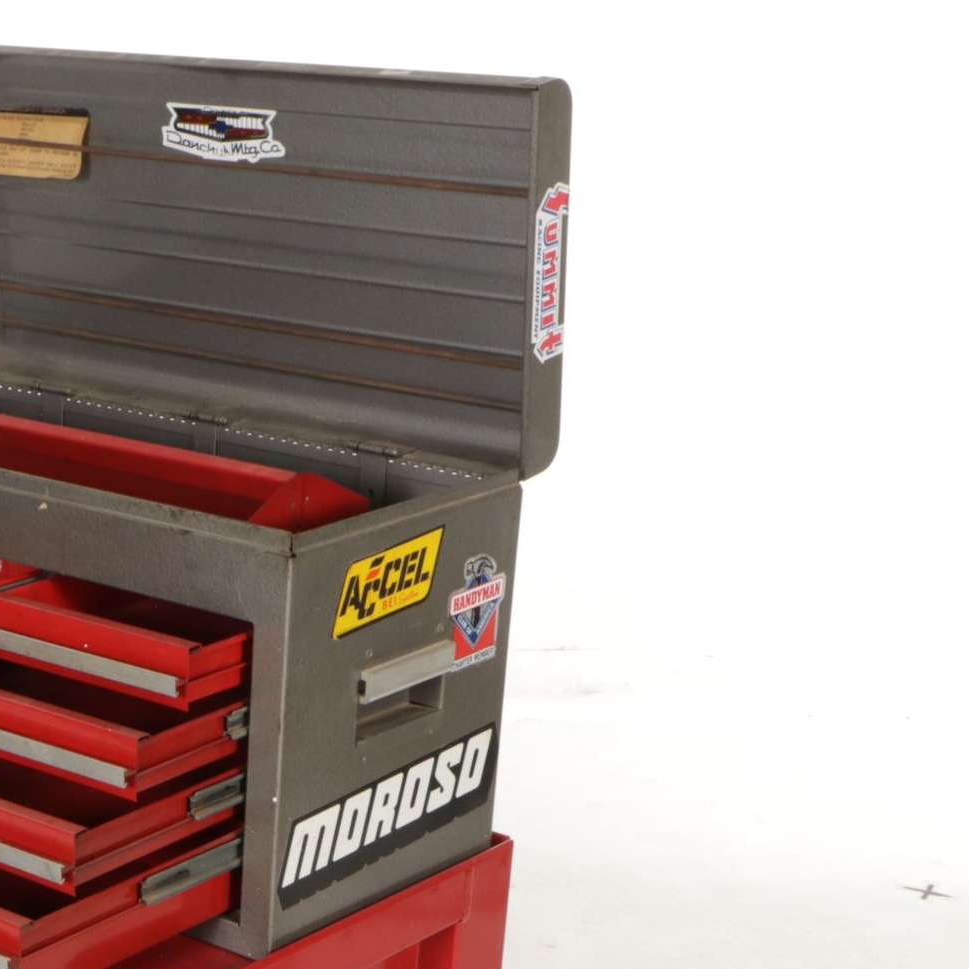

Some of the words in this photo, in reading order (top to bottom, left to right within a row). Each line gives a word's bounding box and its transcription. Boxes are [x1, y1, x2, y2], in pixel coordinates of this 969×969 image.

[339, 546, 430, 620] ACCEL
[453, 580, 501, 612] HANDYMAN
[281, 727, 493, 889] MOROSO
